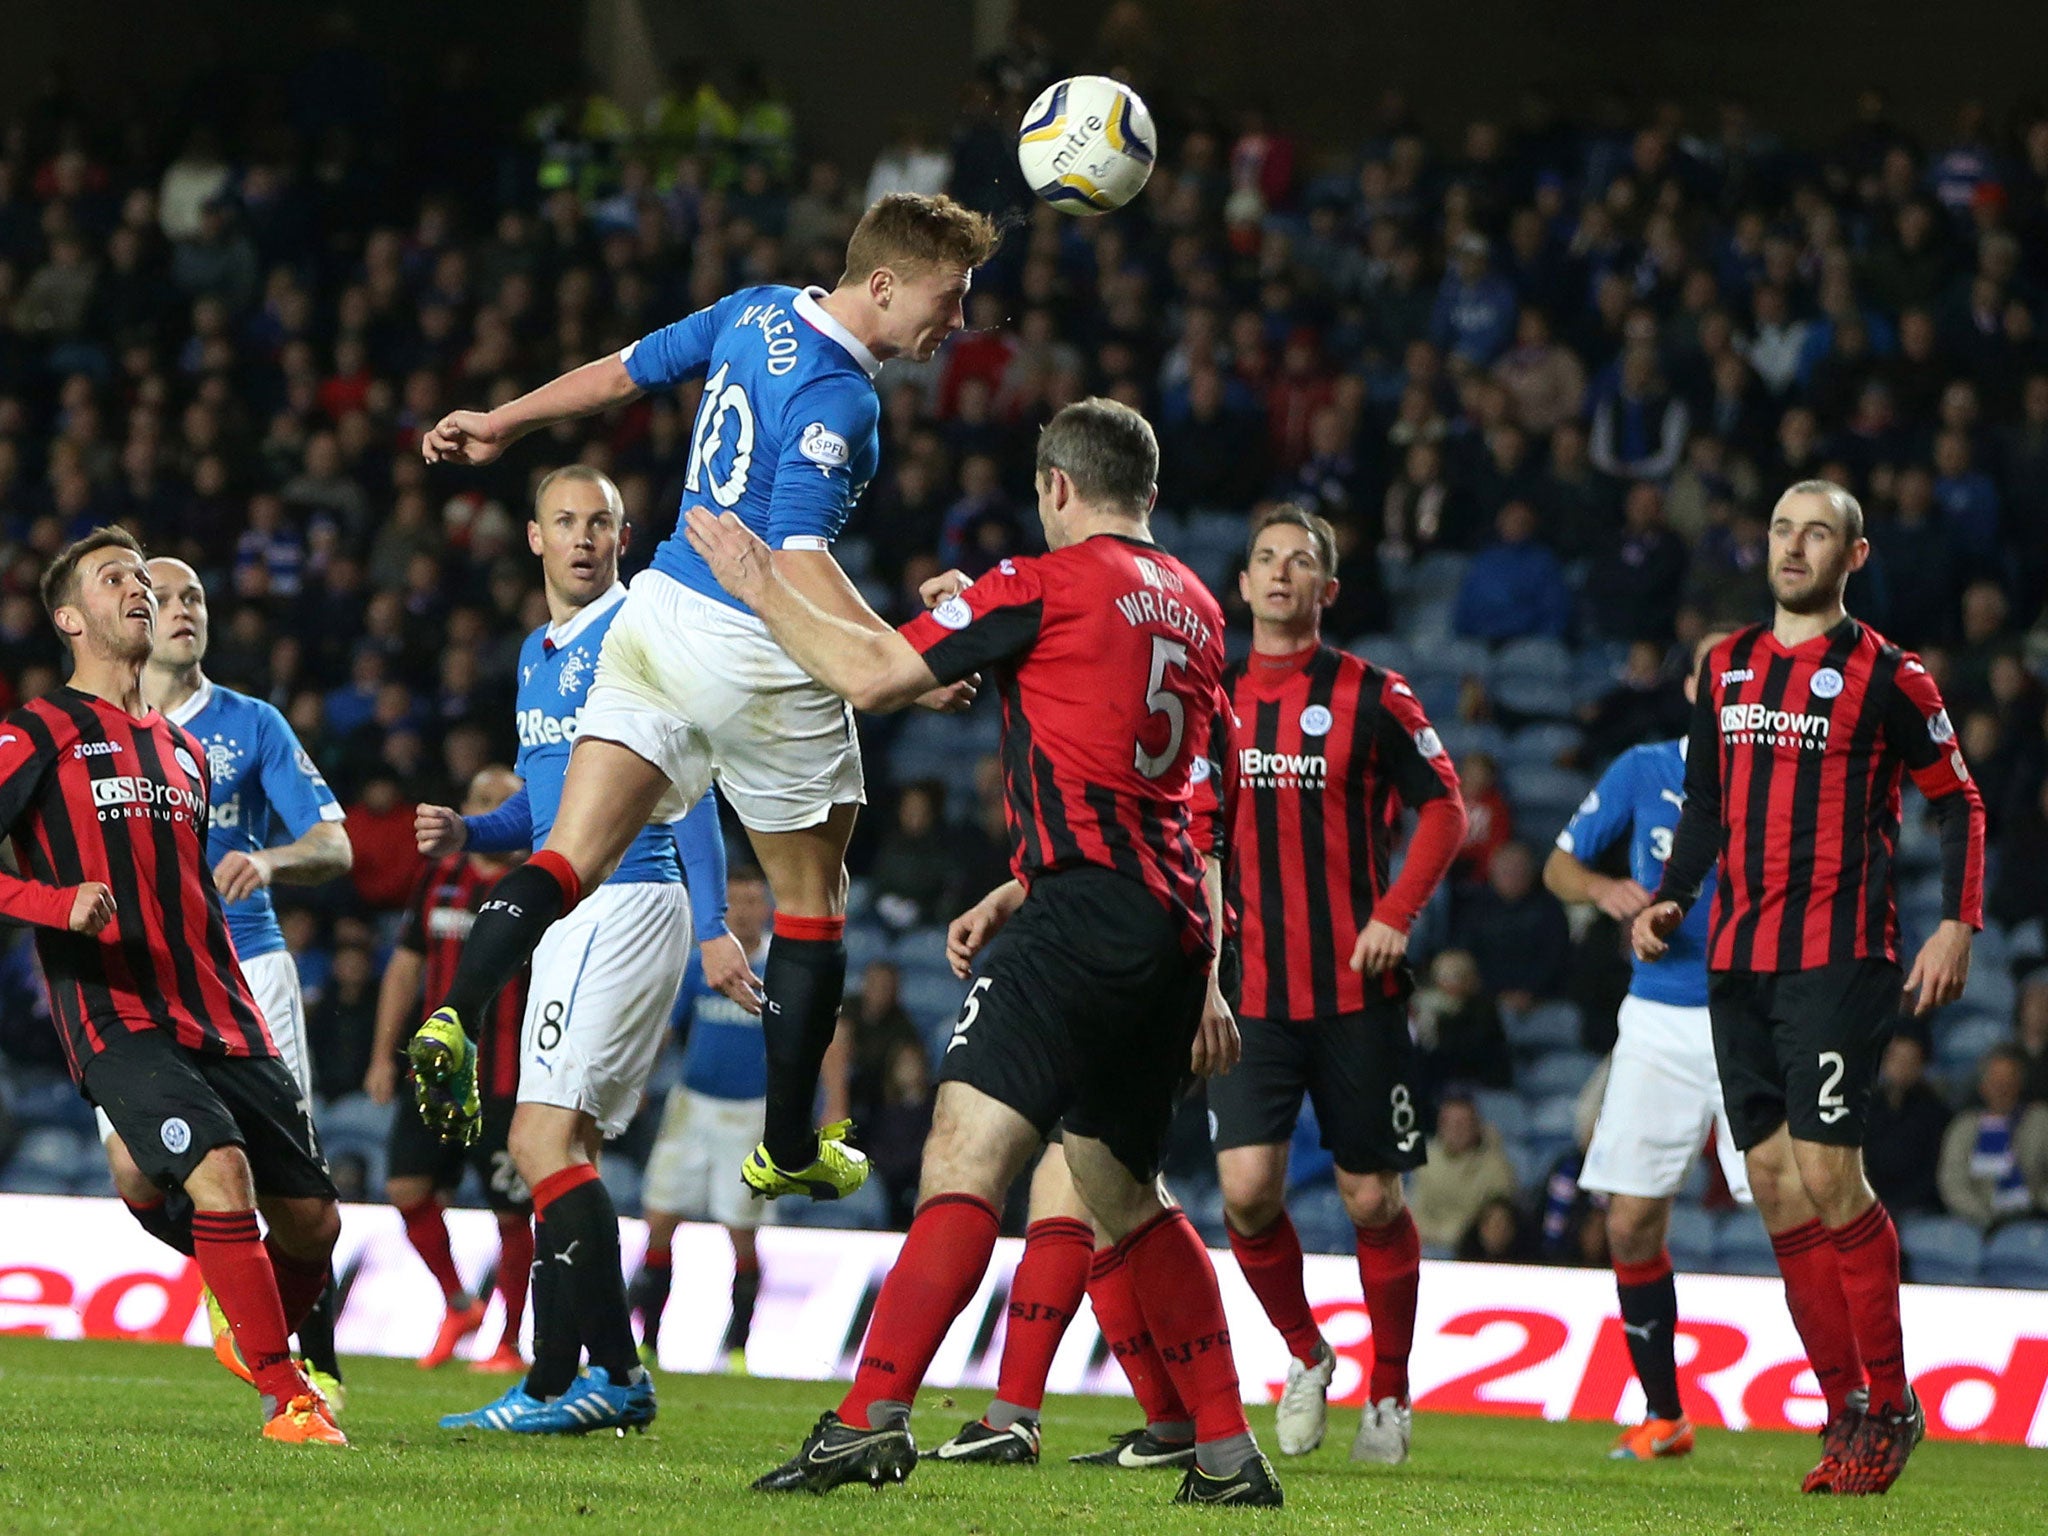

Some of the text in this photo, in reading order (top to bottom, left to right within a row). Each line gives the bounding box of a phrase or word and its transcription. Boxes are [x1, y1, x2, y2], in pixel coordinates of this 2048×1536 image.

[1053, 116, 1102, 174] mitre
[685, 361, 755, 508] 10
[815, 439, 844, 458] SPFL
[1115, 591, 1211, 650] WRIGHT
[516, 707, 584, 747] 2Red
[1134, 634, 1188, 779] 5
[954, 976, 993, 1034] 5
[1818, 1050, 1845, 1107] 2
[1390, 1084, 1415, 1134] 8
